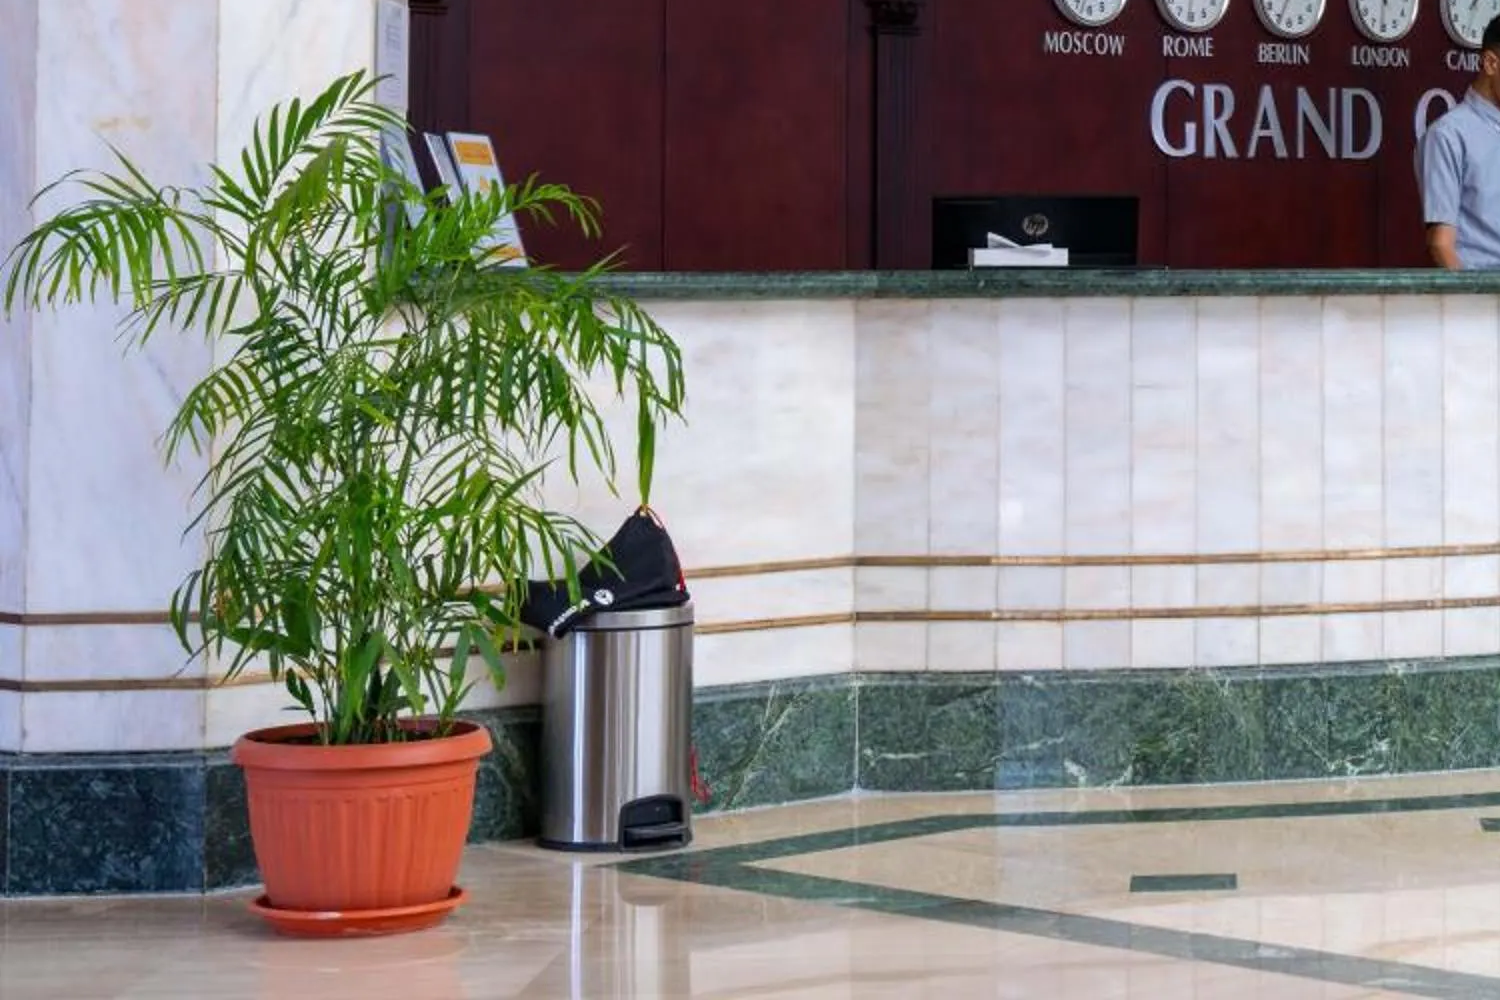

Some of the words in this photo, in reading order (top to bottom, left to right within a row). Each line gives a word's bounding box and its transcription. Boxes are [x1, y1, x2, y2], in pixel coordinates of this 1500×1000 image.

[1044, 31, 1125, 56] MOSCOW
[1163, 35, 1214, 57] ROME
[1258, 43, 1310, 65] BERLIN
[1351, 46, 1410, 68] LONDON
[1446, 50, 1480, 72] CAIR
[1150, 79, 1383, 161] GRAND
